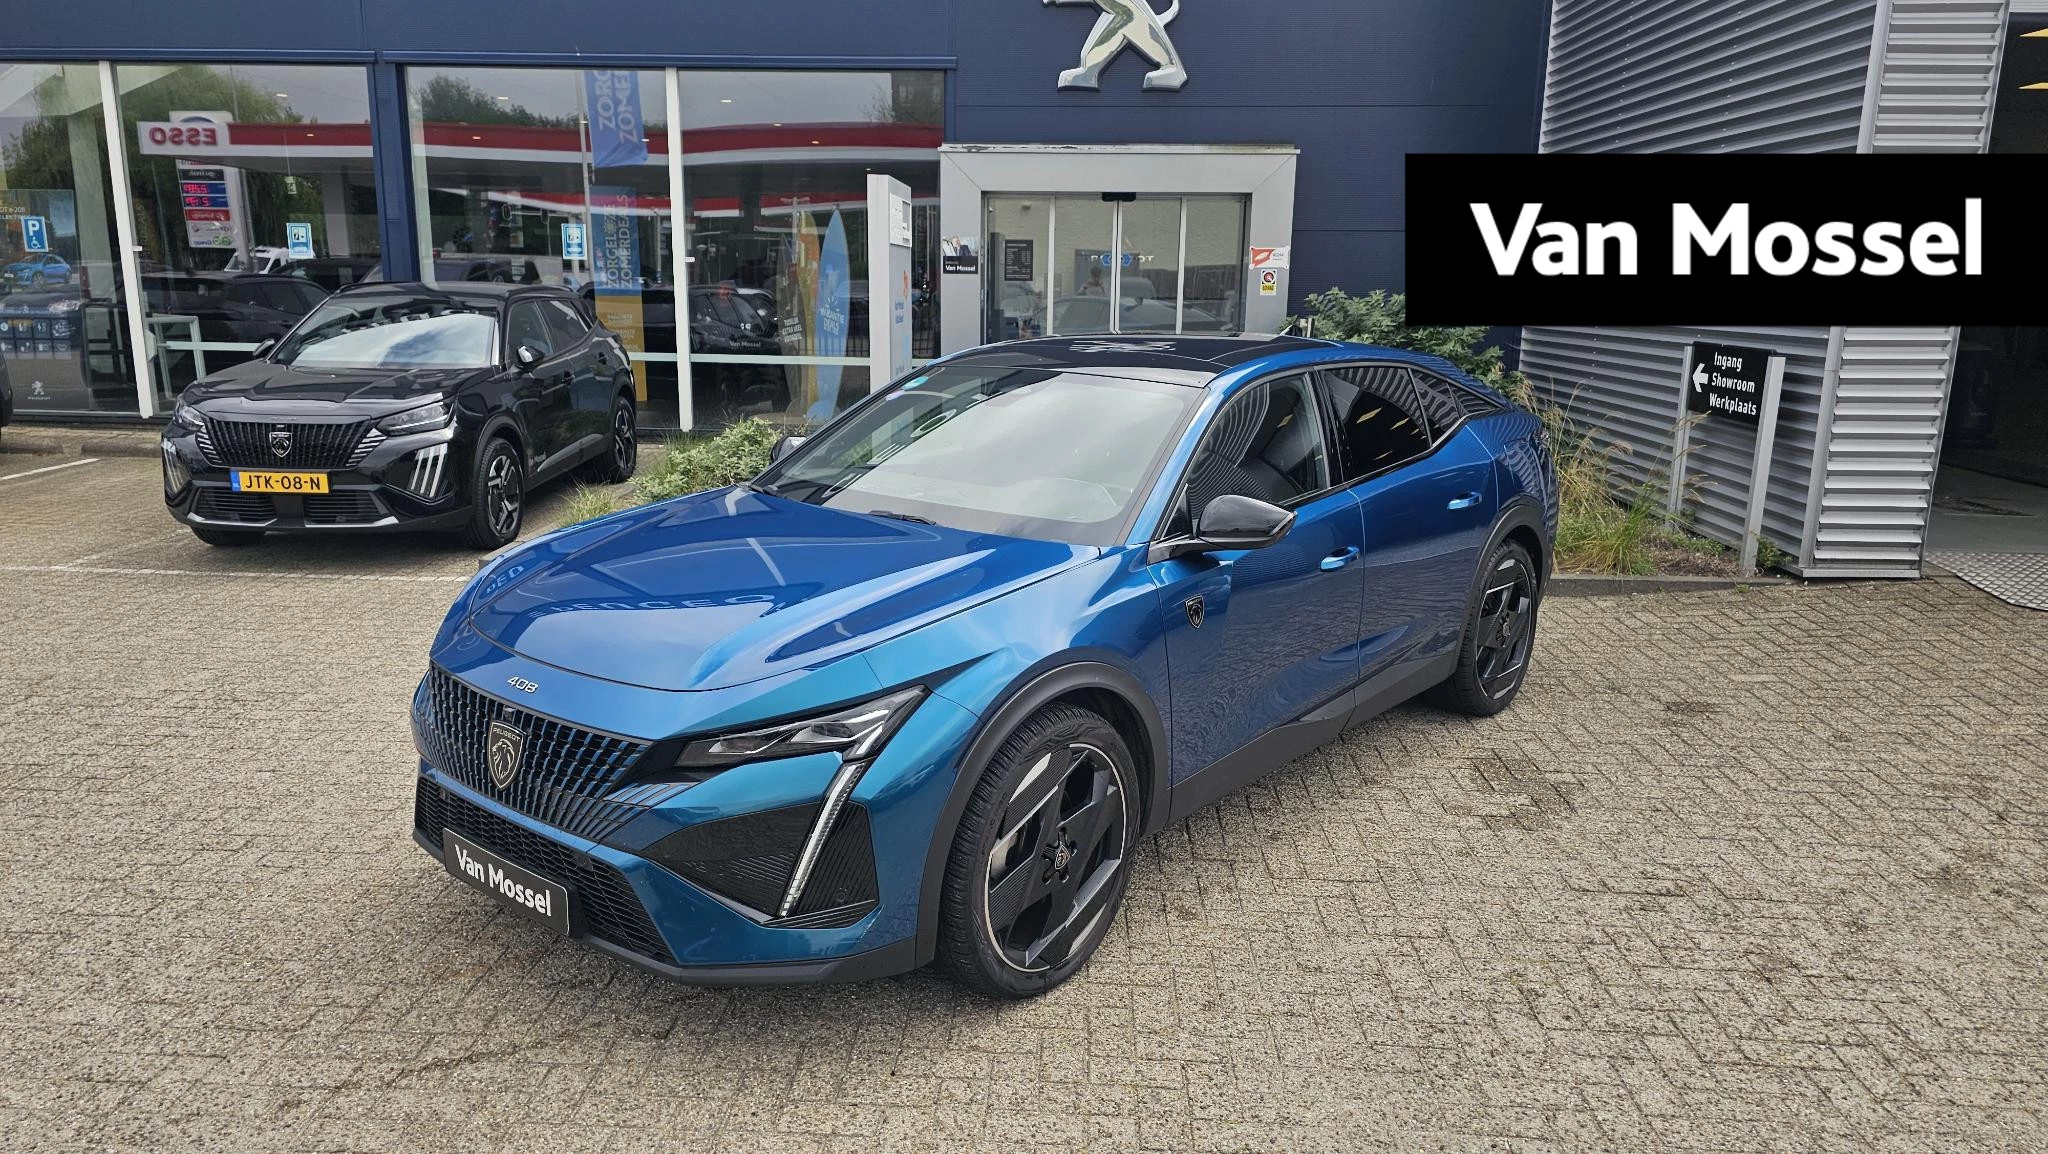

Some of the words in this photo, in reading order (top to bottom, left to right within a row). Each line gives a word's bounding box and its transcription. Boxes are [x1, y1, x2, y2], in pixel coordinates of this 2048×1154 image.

[28, 220, 40, 236] P
[956, 264, 976, 272] Mossel
[1713, 351, 1743, 372] Ingang
[1711, 372, 1755, 393] Showroom
[1708, 392, 1757, 416] Werkplaats
[245, 475, 321, 491] JTK-08-N
[507, 675, 539, 693] 408
[492, 726, 521, 743] PEUGEOT
[454, 843, 485, 884] Van
[487, 862, 552, 917] Mossel
